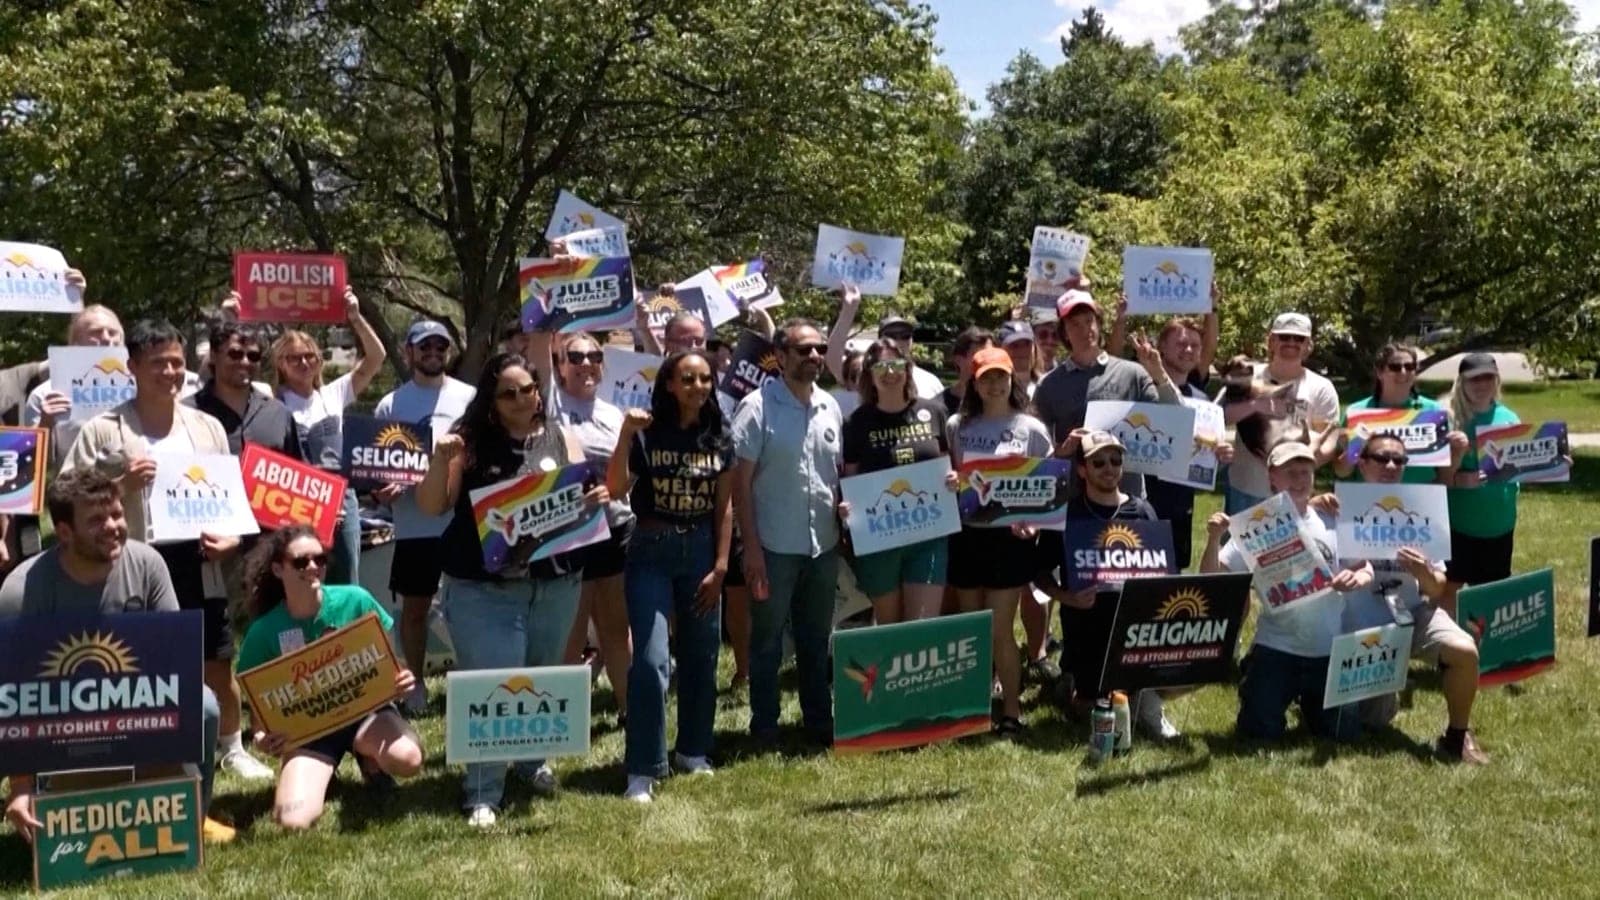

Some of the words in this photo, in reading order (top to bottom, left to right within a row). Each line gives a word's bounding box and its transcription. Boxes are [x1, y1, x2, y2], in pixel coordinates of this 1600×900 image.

[248, 263, 334, 286] ABOLISH
[255, 288, 329, 310] ICE!
[72, 386, 137, 404] KIRO
[869, 422, 932, 442] SUNRISE
[351, 445, 431, 472] SELIGMA
[651, 449, 679, 467] HOT
[253, 458, 333, 504] ABOLISH
[250, 484, 323, 528] ICE!
[867, 504, 943, 534] KIROS
[1353, 524, 1433, 542] KIROS
[1074, 549, 1167, 568] SELIGMAN
[1124, 618, 1229, 649] SELIGMAN
[1121, 653, 1140, 664] FOR
[1341, 648, 1398, 670] MELAT
[260, 682, 301, 710] THE
[302, 643, 387, 695] FEDERAL
[884, 658, 977, 691] GONZALES
[0, 674, 179, 718] SELIGMAN
[280, 667, 379, 718] MINIMUM
[469, 698, 569, 719] MELAT
[37, 719, 109, 737] ATTORNEY
[116, 715, 175, 731] GENERAL
[469, 715, 569, 740] KIROS
[46, 793, 188, 838] MEDICARE
[50, 840, 87, 863] for
[85, 825, 189, 865] ALL
